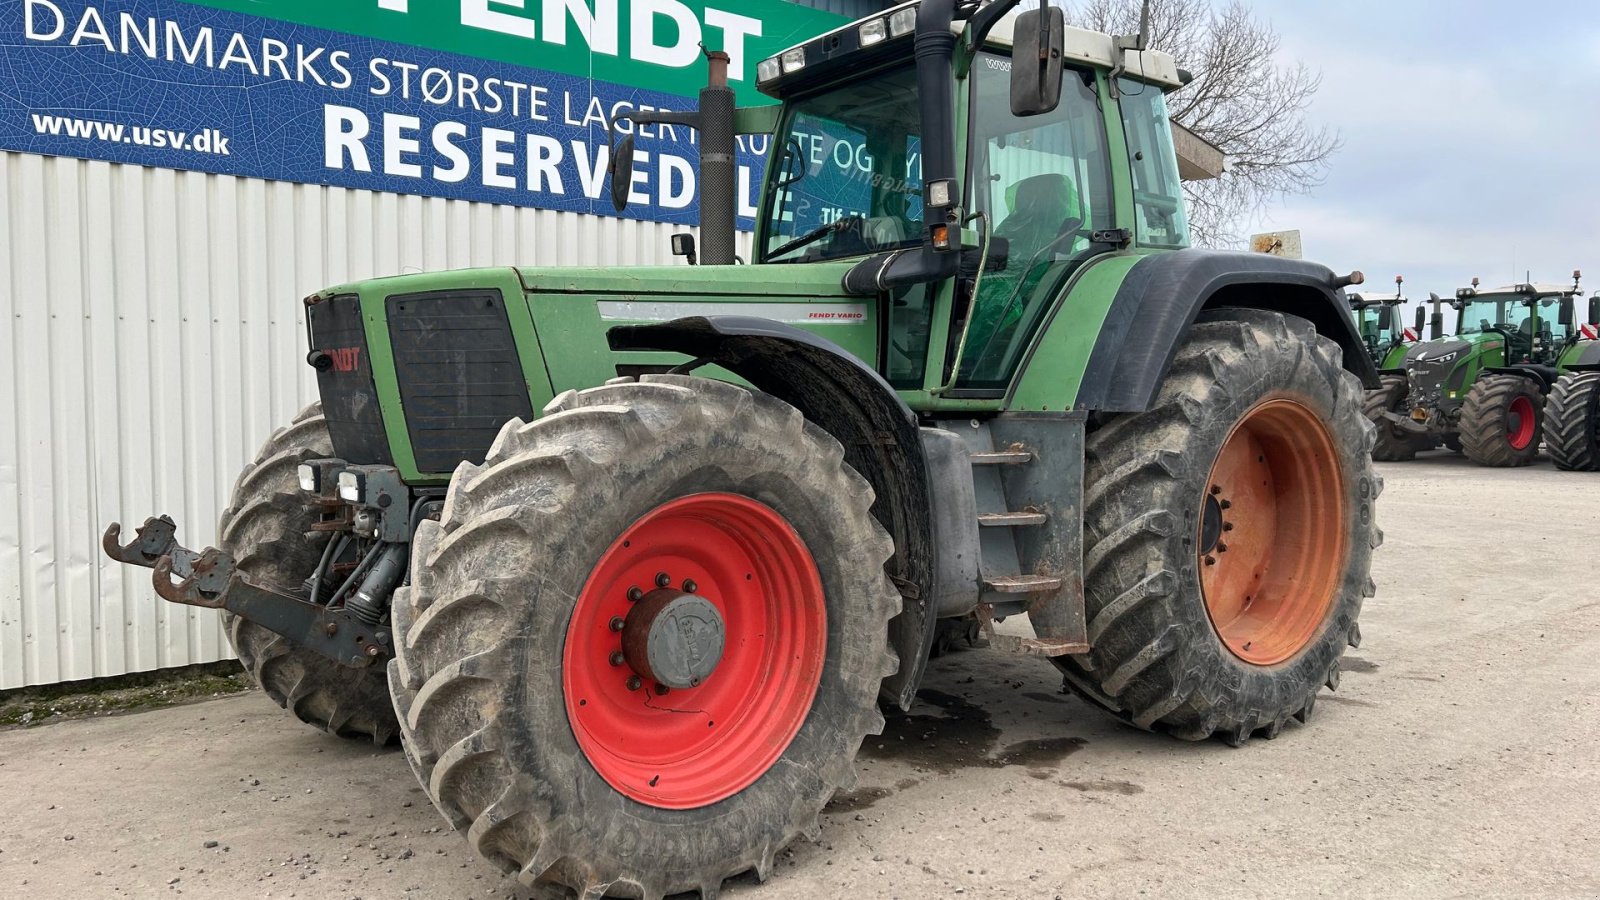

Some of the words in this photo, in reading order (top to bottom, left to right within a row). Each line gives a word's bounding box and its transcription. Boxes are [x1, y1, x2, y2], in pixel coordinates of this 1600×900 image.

[24, 0, 352, 89] DANMARKS
[369, 58, 548, 121] STØRSTE
[834, 140, 873, 172] OG
[32, 114, 229, 155] www.usv.dk
